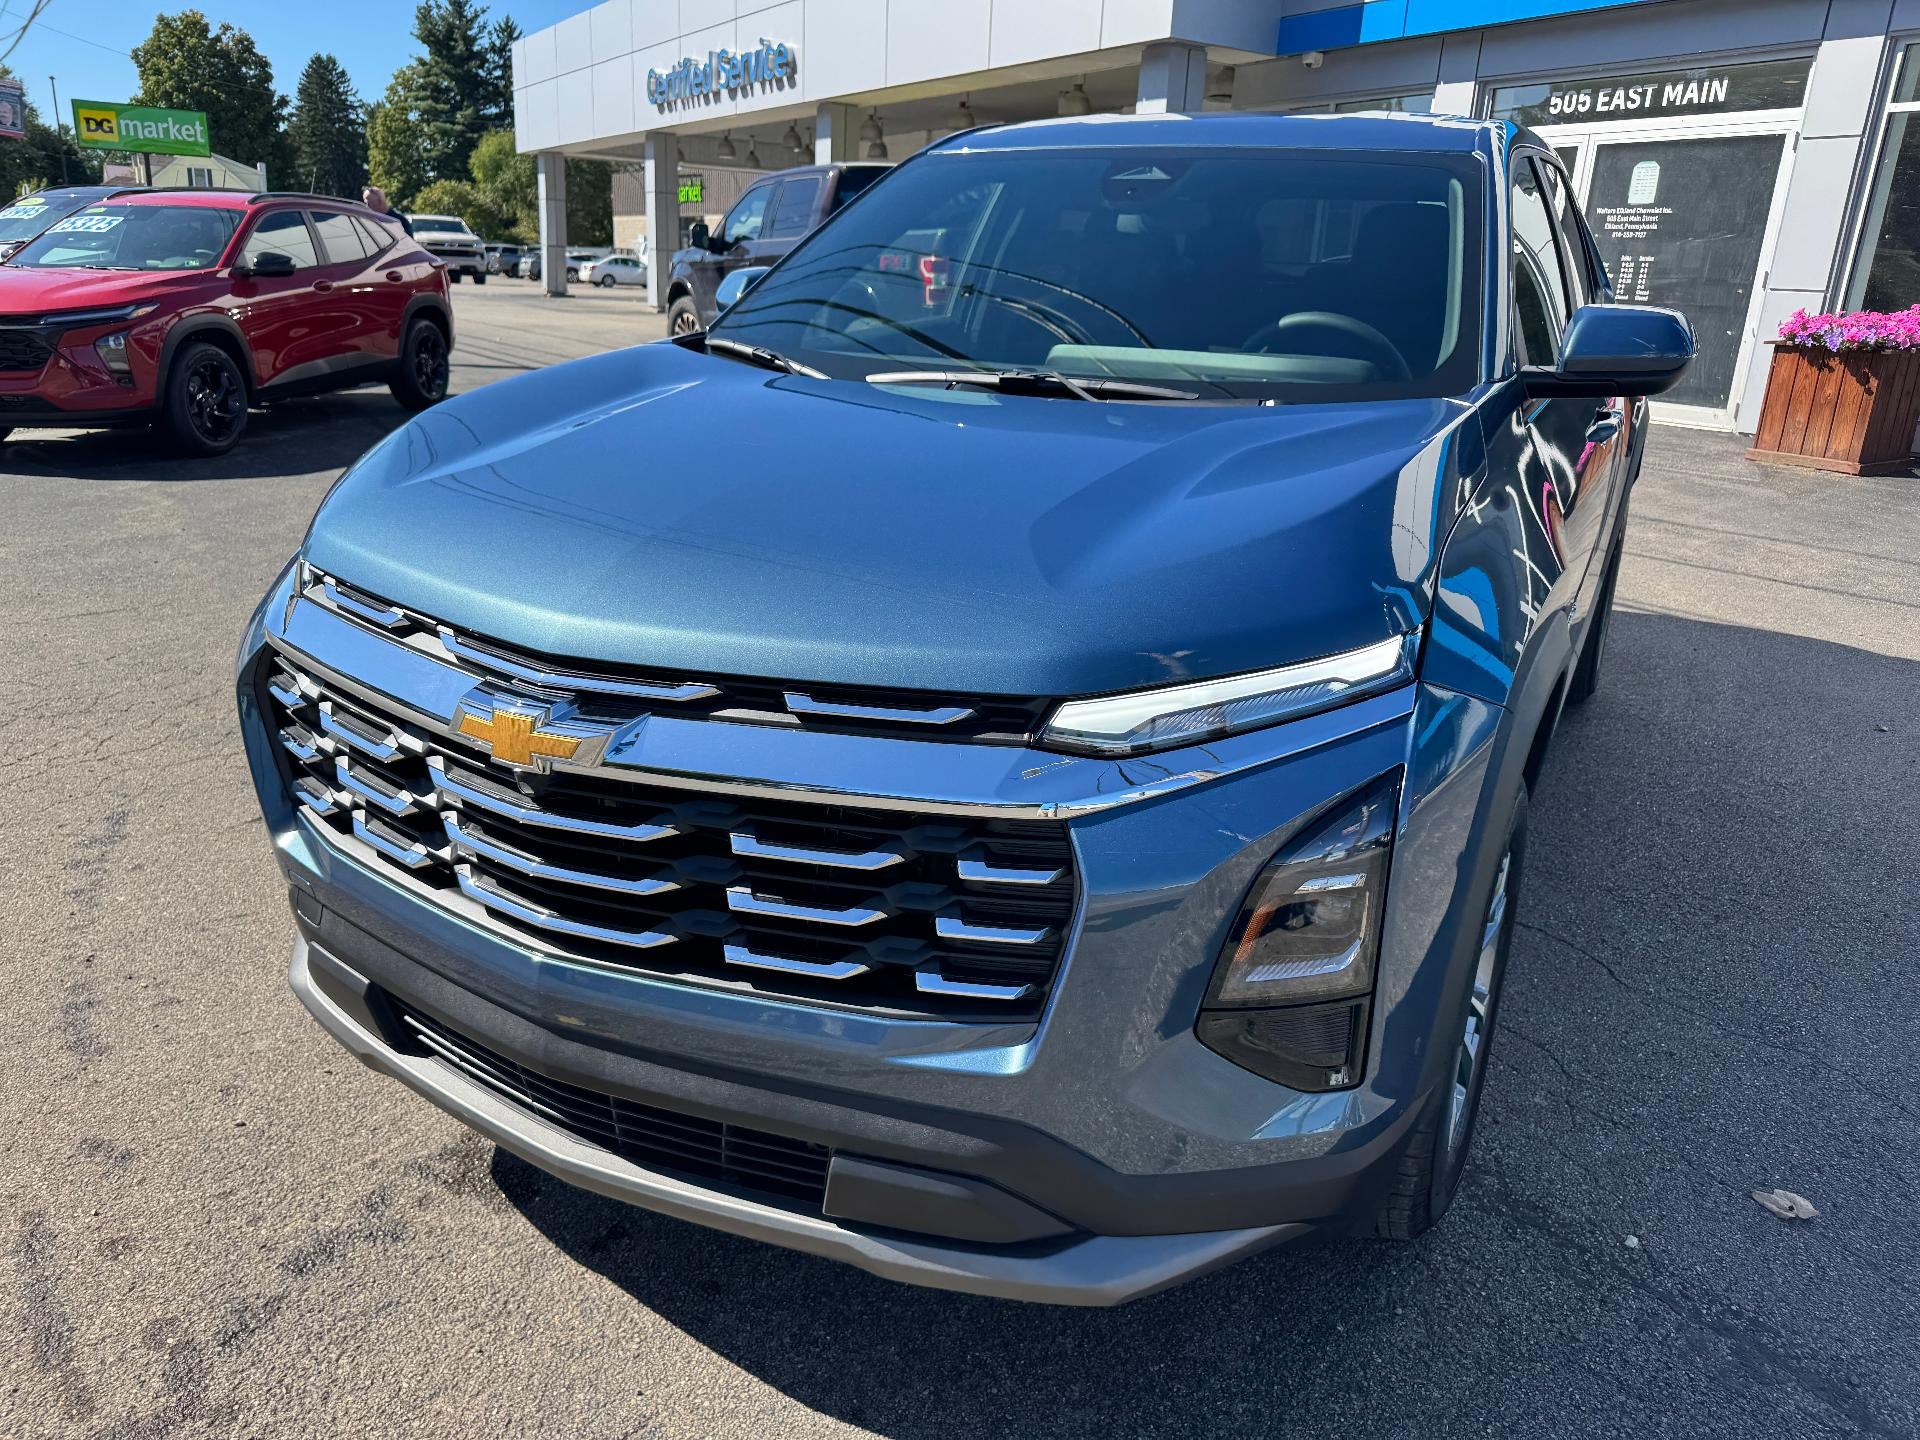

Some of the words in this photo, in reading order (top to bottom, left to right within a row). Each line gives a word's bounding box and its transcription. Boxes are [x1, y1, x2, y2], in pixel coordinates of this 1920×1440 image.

[647, 51, 719, 105] Certified
[718, 38, 790, 89] Service
[1549, 88, 1592, 115] 505
[1596, 82, 1658, 112] EAST
[1661, 77, 1729, 107] MAIN
[83, 117, 114, 134] DG
[119, 117, 205, 143] market
[1641, 214, 1659, 222] Street
